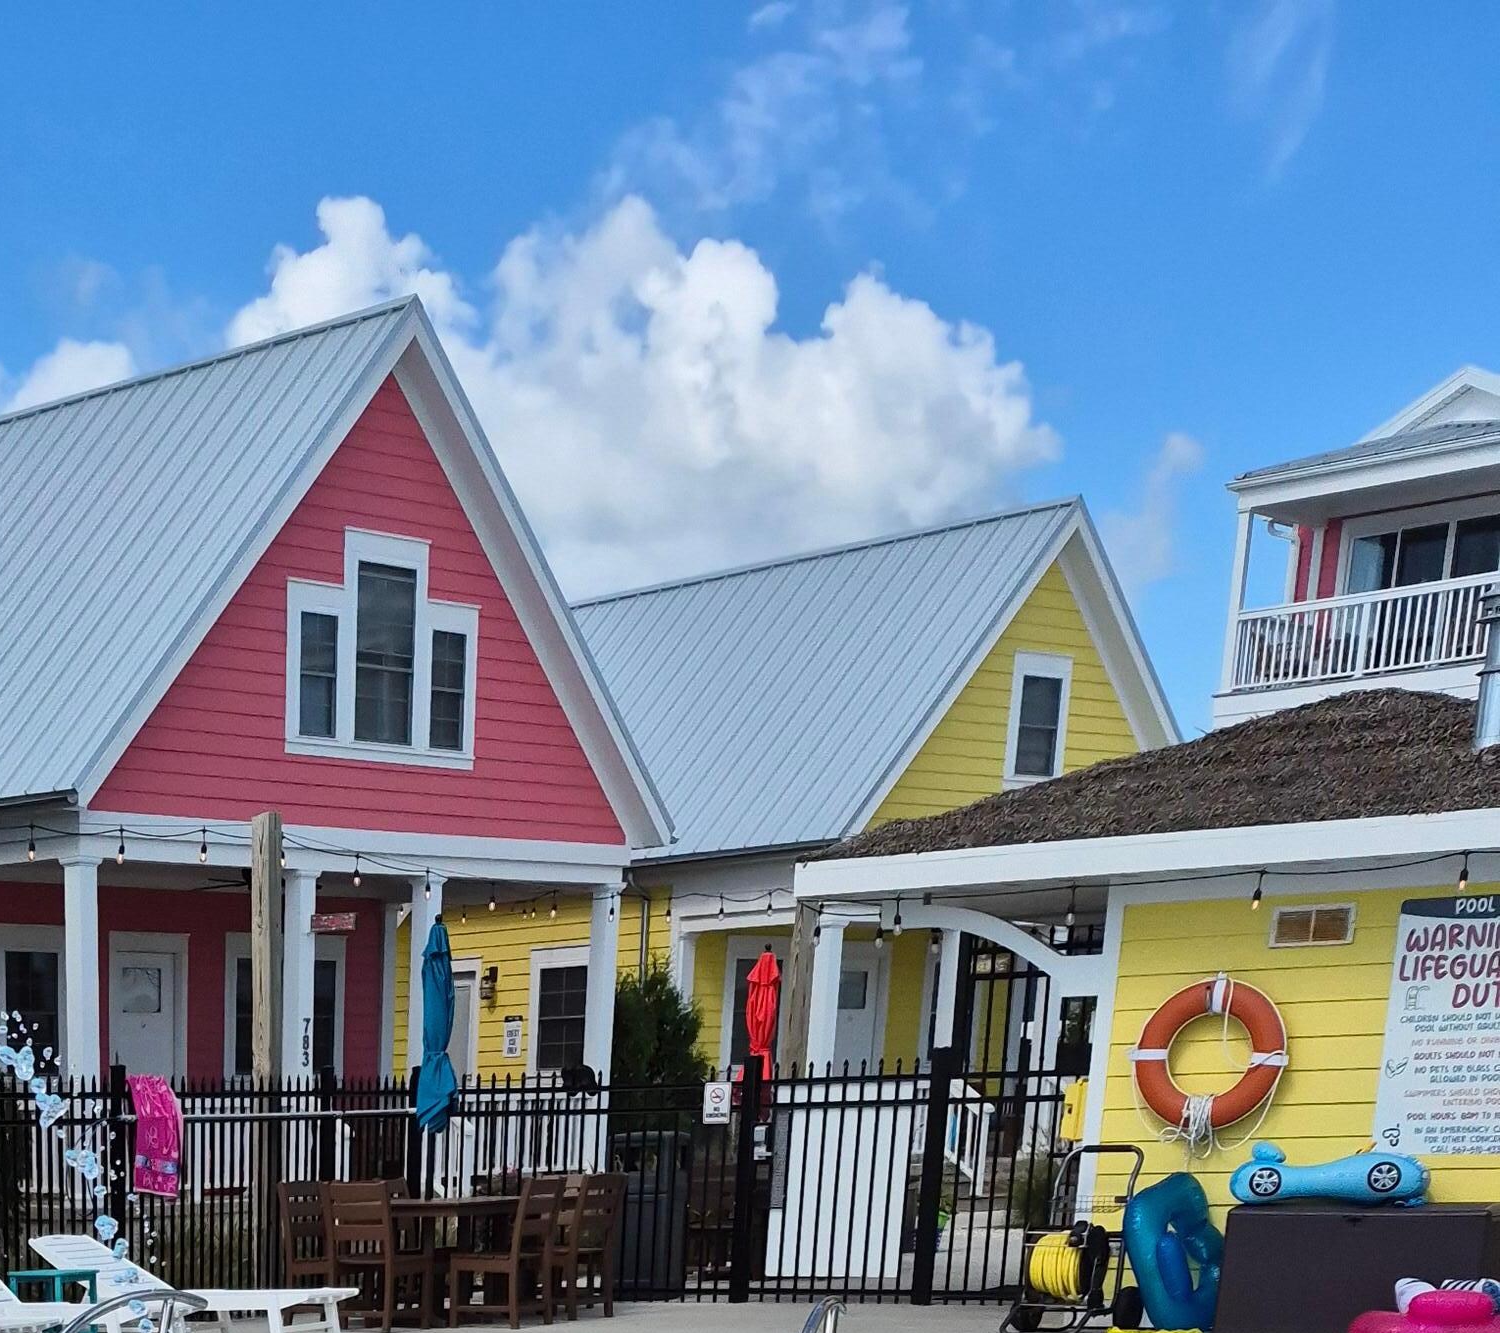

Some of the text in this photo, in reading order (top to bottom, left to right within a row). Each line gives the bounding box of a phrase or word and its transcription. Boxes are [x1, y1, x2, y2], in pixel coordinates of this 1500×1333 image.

[1455, 896, 1496, 914] POOL
[1406, 922, 1500, 952] WARNI
[1400, 1014, 1439, 1024] CHILDREN
[1442, 1013, 1472, 1022] SHOULD
[1475, 1012, 1492, 1021] NOT
[1414, 1024, 1435, 1032] POOL
[1438, 1023, 1474, 1032] WITHOUT
[302, 1017, 311, 1067] 783
[1445, 1050, 1476, 1059] SHOULD
[1478, 1050, 1495, 1059] NOT
[1414, 1066, 1427, 1074] NO
[1407, 1112, 1427, 1120] POOL
[1430, 1112, 1457, 1120] HOURS
[1440, 1125, 1490, 1134] EMERGENCY
[1442, 1135, 1466, 1143] OTHER
